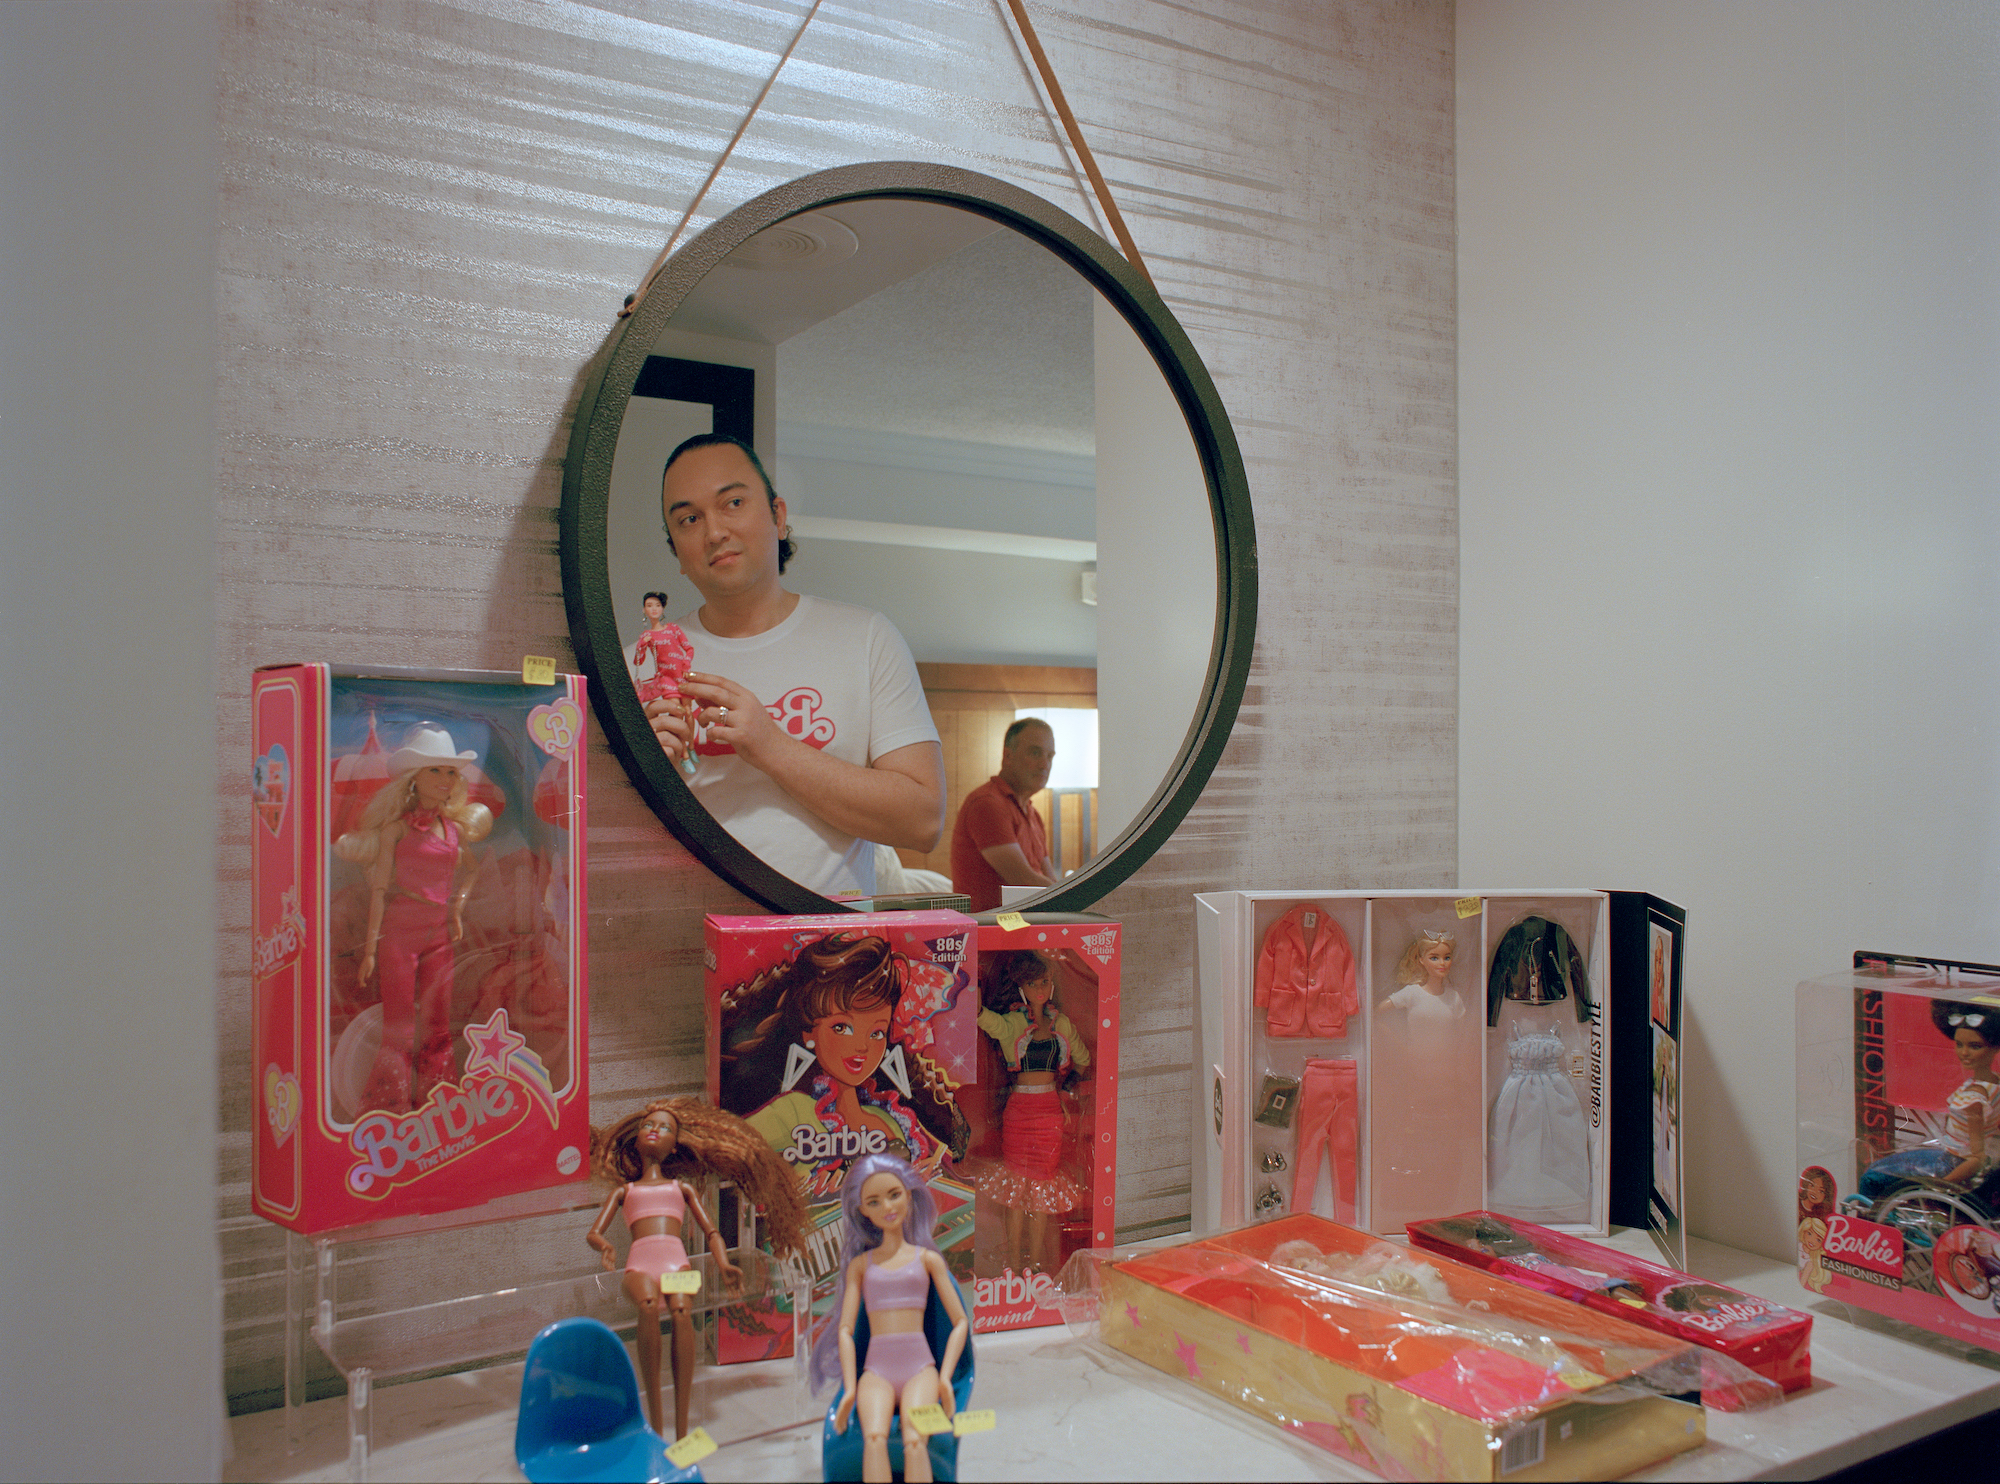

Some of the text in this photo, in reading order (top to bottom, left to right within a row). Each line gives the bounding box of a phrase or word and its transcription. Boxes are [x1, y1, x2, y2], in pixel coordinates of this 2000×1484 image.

[527, 657, 554, 668] PRICE
[544, 712, 573, 754] B
[998, 913, 1020, 922] PRICE
[936, 938, 963, 952] 80s
[1087, 945, 1115, 955] Edition
[1091, 934, 1112, 945] 80s
[932, 951, 967, 963] Edition
[1590, 1001, 1602, 1128] @BARBIESTYLE
[350, 1078, 515, 1192] Barbie
[782, 1124, 887, 1162] Barbie
[415, 1134, 476, 1172] The Movie
[1824, 1215, 1900, 1266] Barbie
[1821, 1257, 1900, 1290] FASHIONISTAS
[973, 1304, 1038, 1329] ewind
[1682, 1303, 1764, 1332] Barbie
